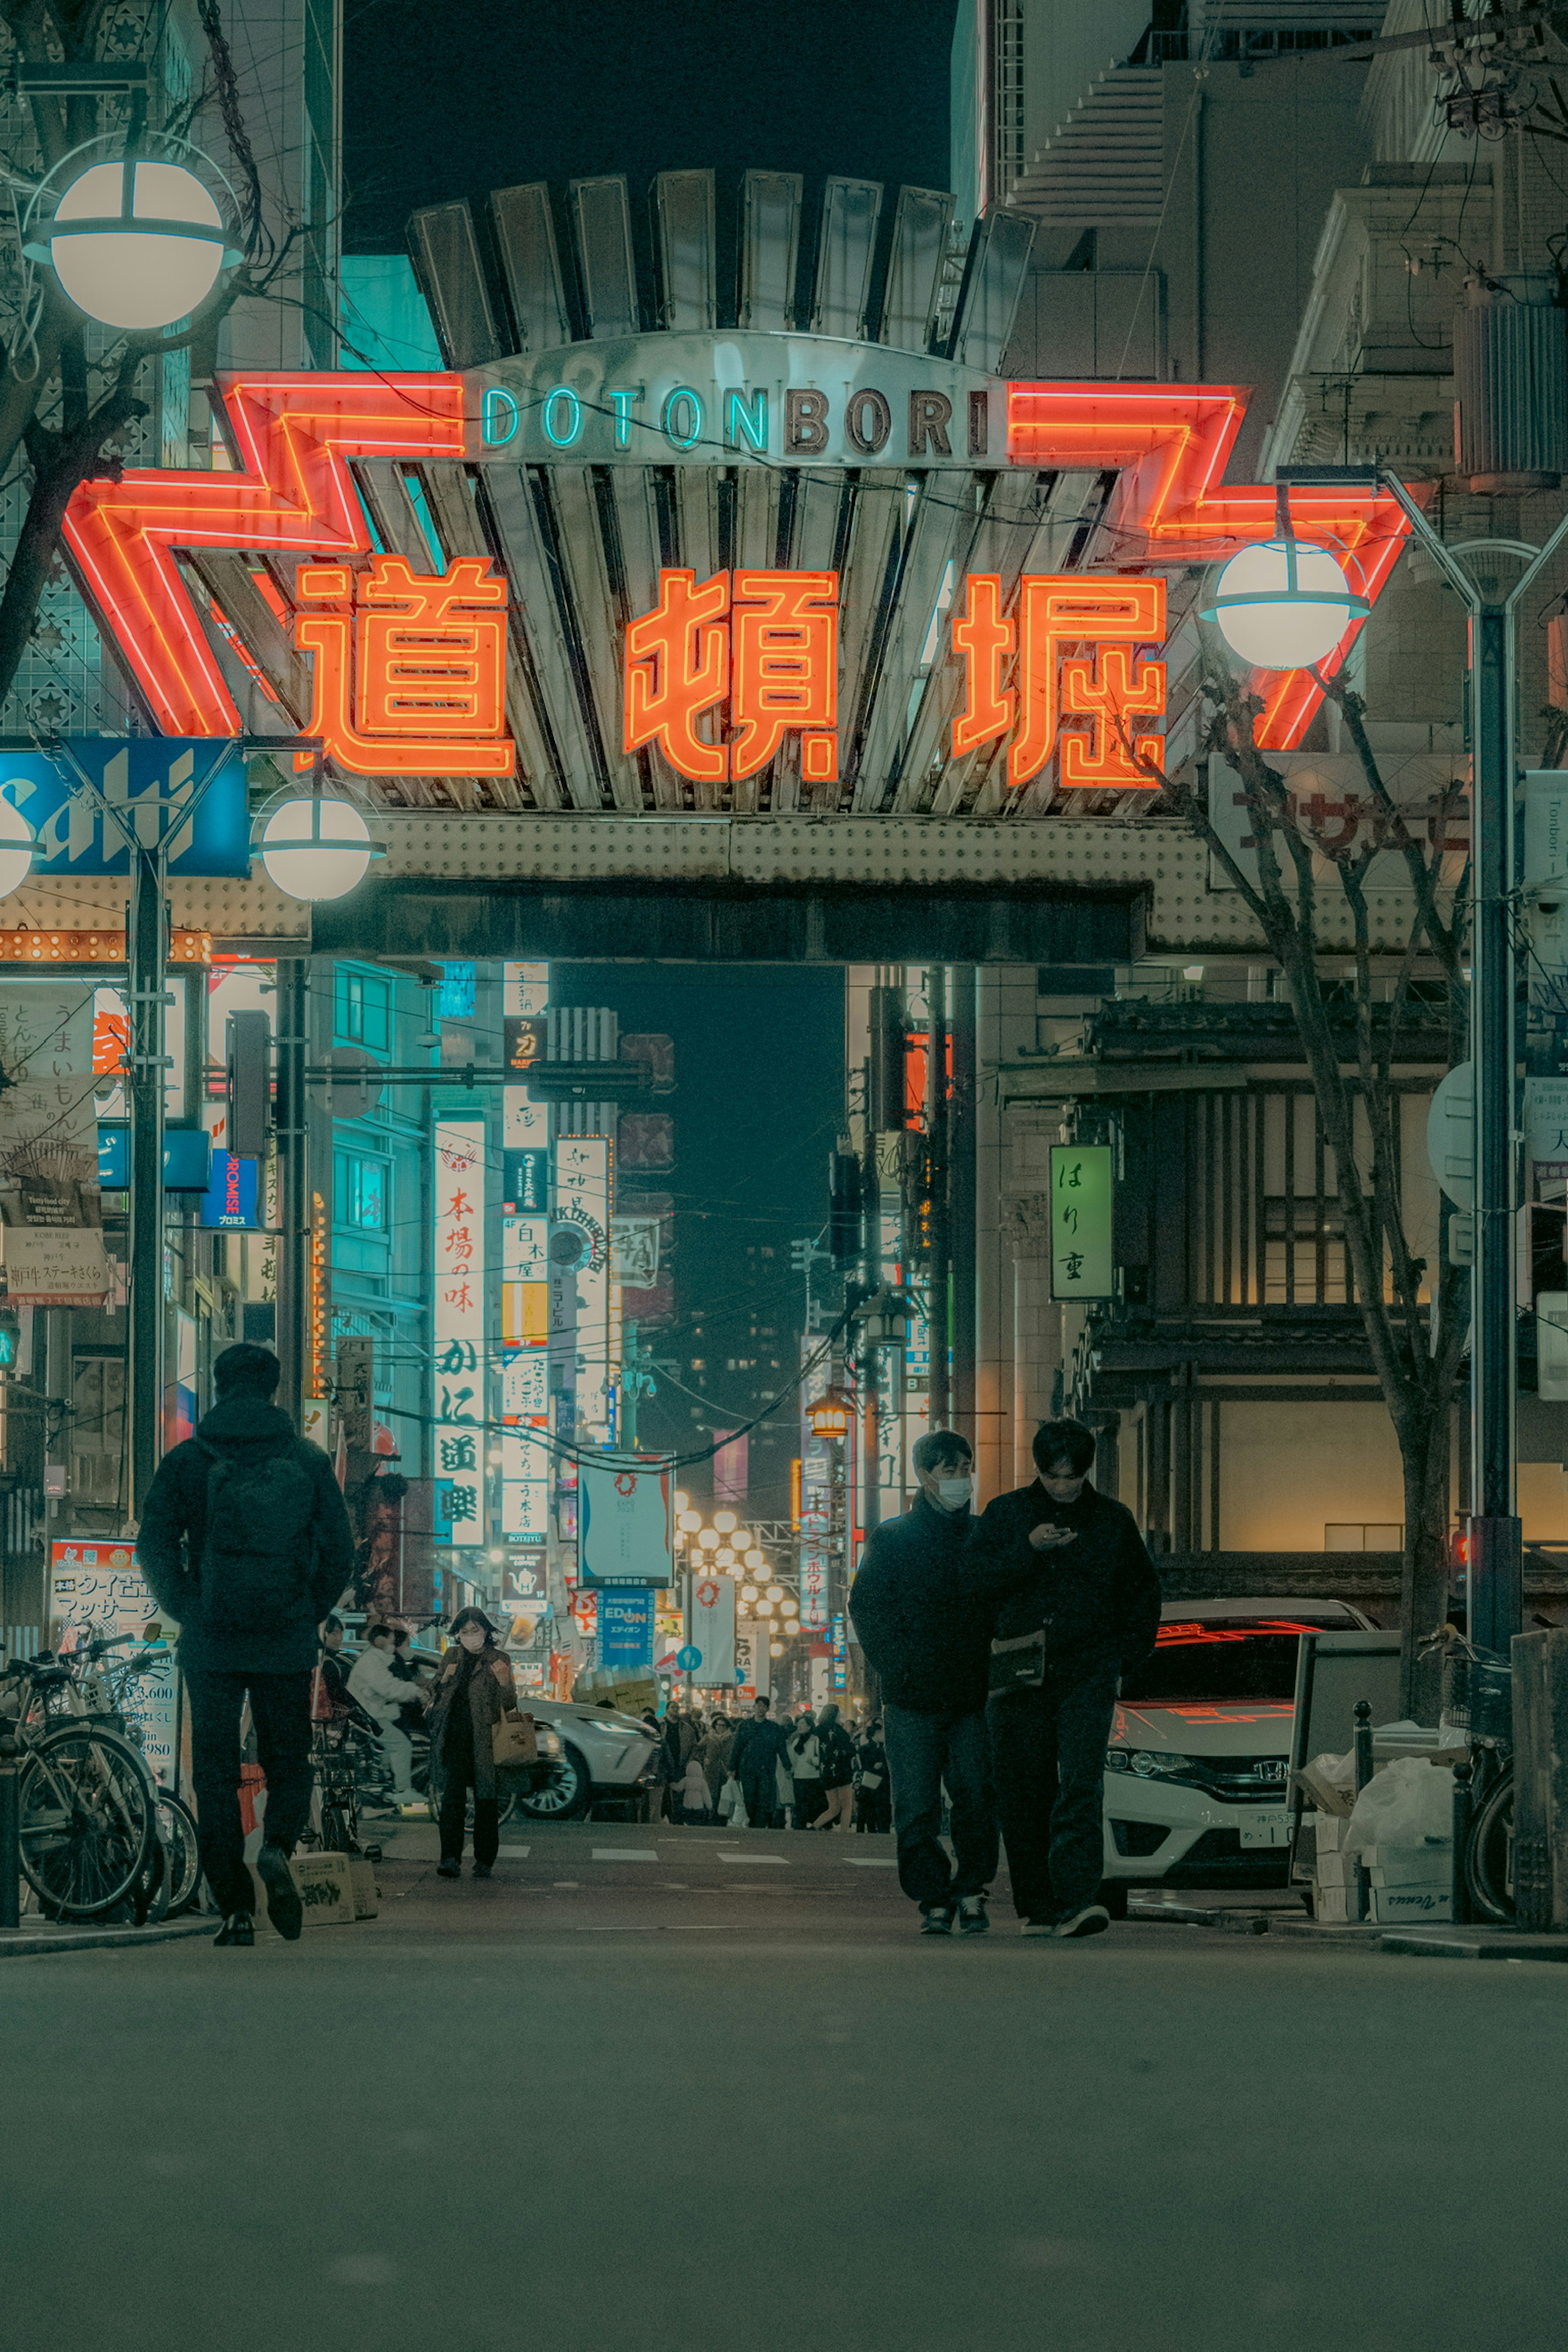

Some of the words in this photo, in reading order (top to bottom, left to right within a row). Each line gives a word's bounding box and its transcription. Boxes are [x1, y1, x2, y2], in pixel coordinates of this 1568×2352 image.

[480, 385, 988, 457] DOTONBORI
[292, 554, 1168, 790] 道頓堀
[53, 1004, 77, 1130] うまいもん
[58, 1197, 70, 1206] city
[219, 1215, 245, 1225] プロミス
[505, 1221, 516, 1229] 4F
[1057, 1163, 1085, 1280] はり重
[445, 1187, 474, 1314] 本場の味
[518, 1223, 544, 1277] 白木屋
[43, 1265, 101, 1280] ステーキさくら
[57, 1598, 158, 1620] マッサージ
[605, 1607, 646, 1624] EDION
